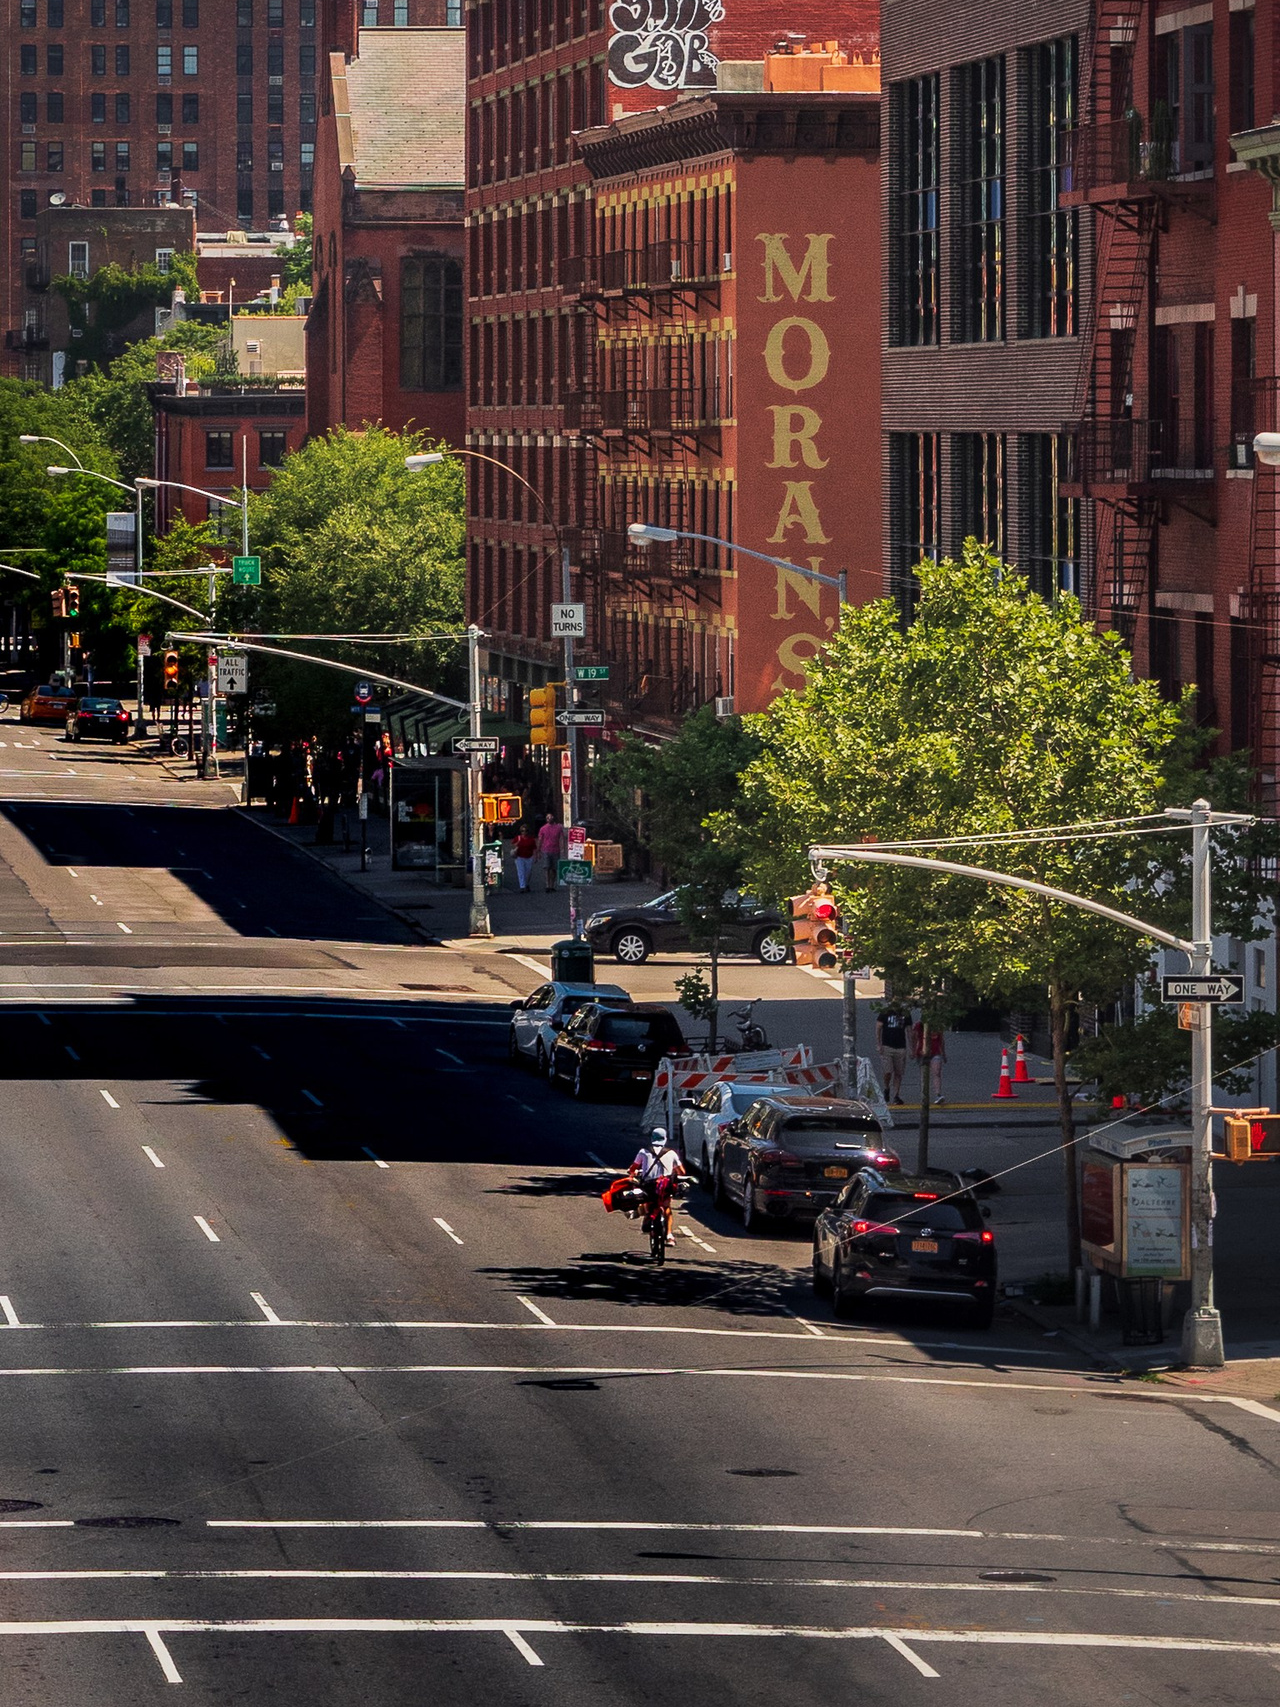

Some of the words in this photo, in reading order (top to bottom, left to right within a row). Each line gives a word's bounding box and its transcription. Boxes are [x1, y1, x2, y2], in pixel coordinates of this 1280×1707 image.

[754, 232, 838, 695] MORAN'S
[560, 609, 574, 619] NO
[553, 622, 583, 632] TURNS
[225, 659, 239, 667] ALL
[219, 668, 245, 676] TRAFFIC
[577, 669, 585, 678] W
[588, 668, 597, 678] 19
[559, 714, 575, 722] ONE
[584, 714, 600, 722] WAY
[1174, 984, 1197, 994] ONE
[1207, 984, 1232, 995] WAY
